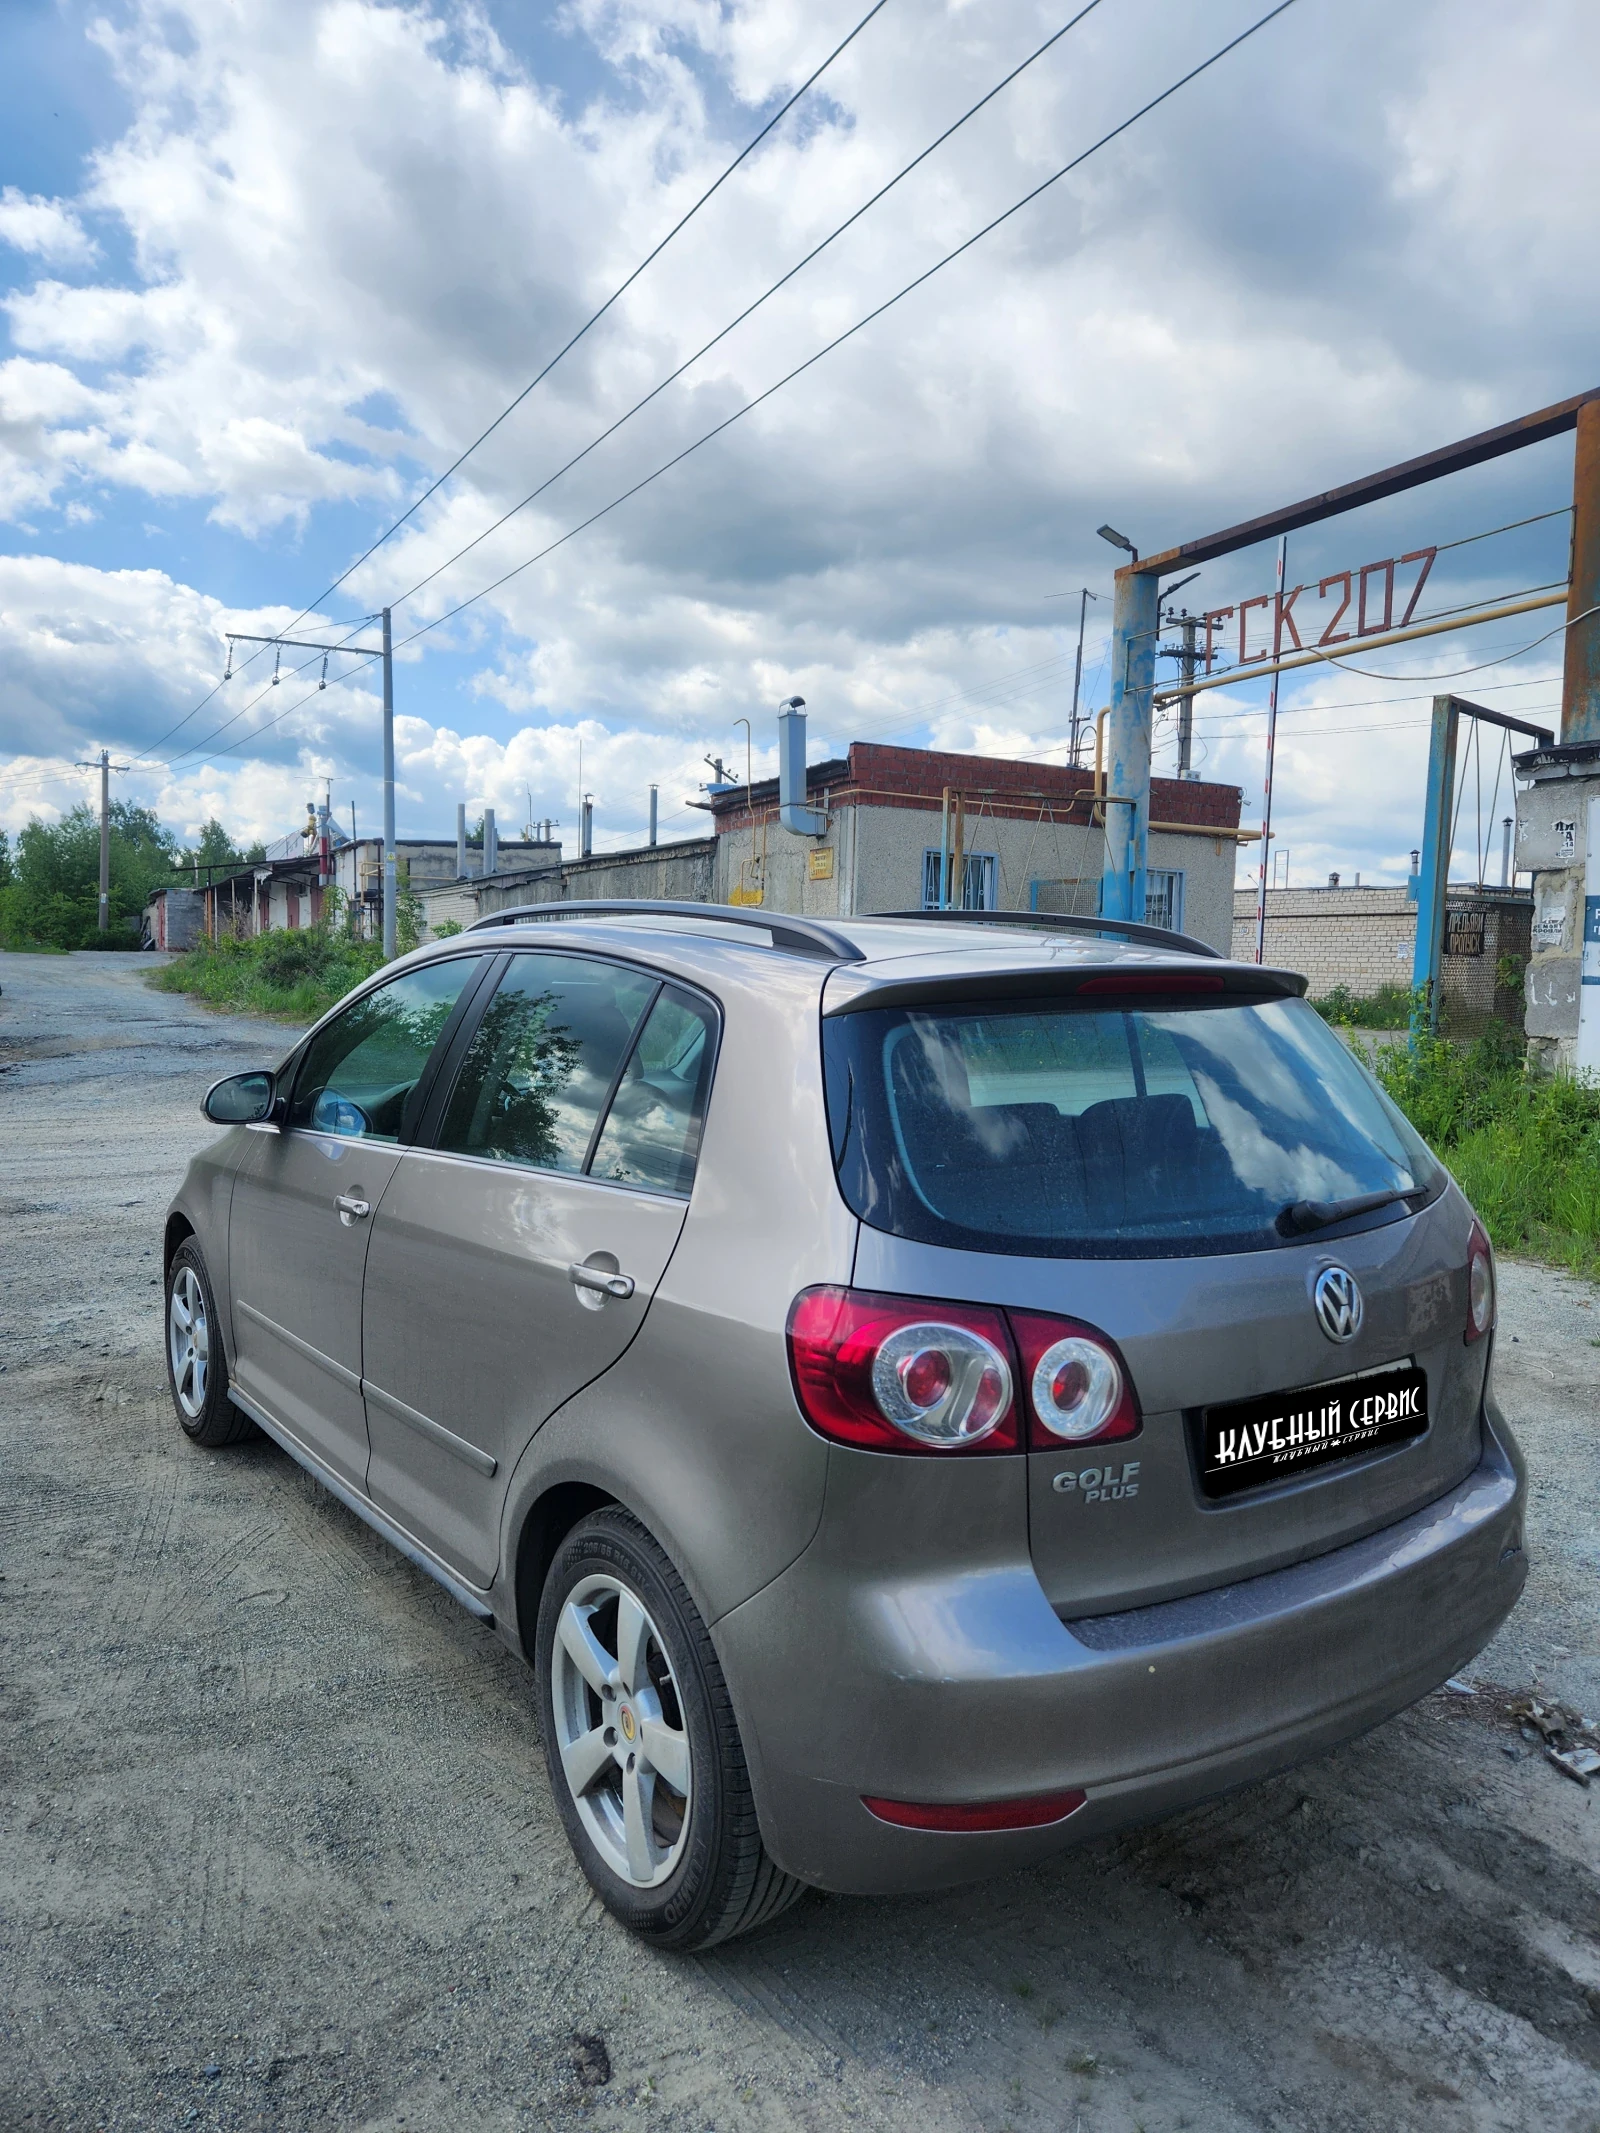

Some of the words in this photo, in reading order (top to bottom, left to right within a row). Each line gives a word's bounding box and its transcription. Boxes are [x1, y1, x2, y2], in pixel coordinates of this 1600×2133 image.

[1206, 584, 1304, 675] ГСК
[1319, 546, 1437, 648] 207
[1450, 933, 1481, 953] ПРОПУСК
[1053, 1462, 1140, 1493] GOLF
[1085, 1484, 1139, 1504] PLUS
